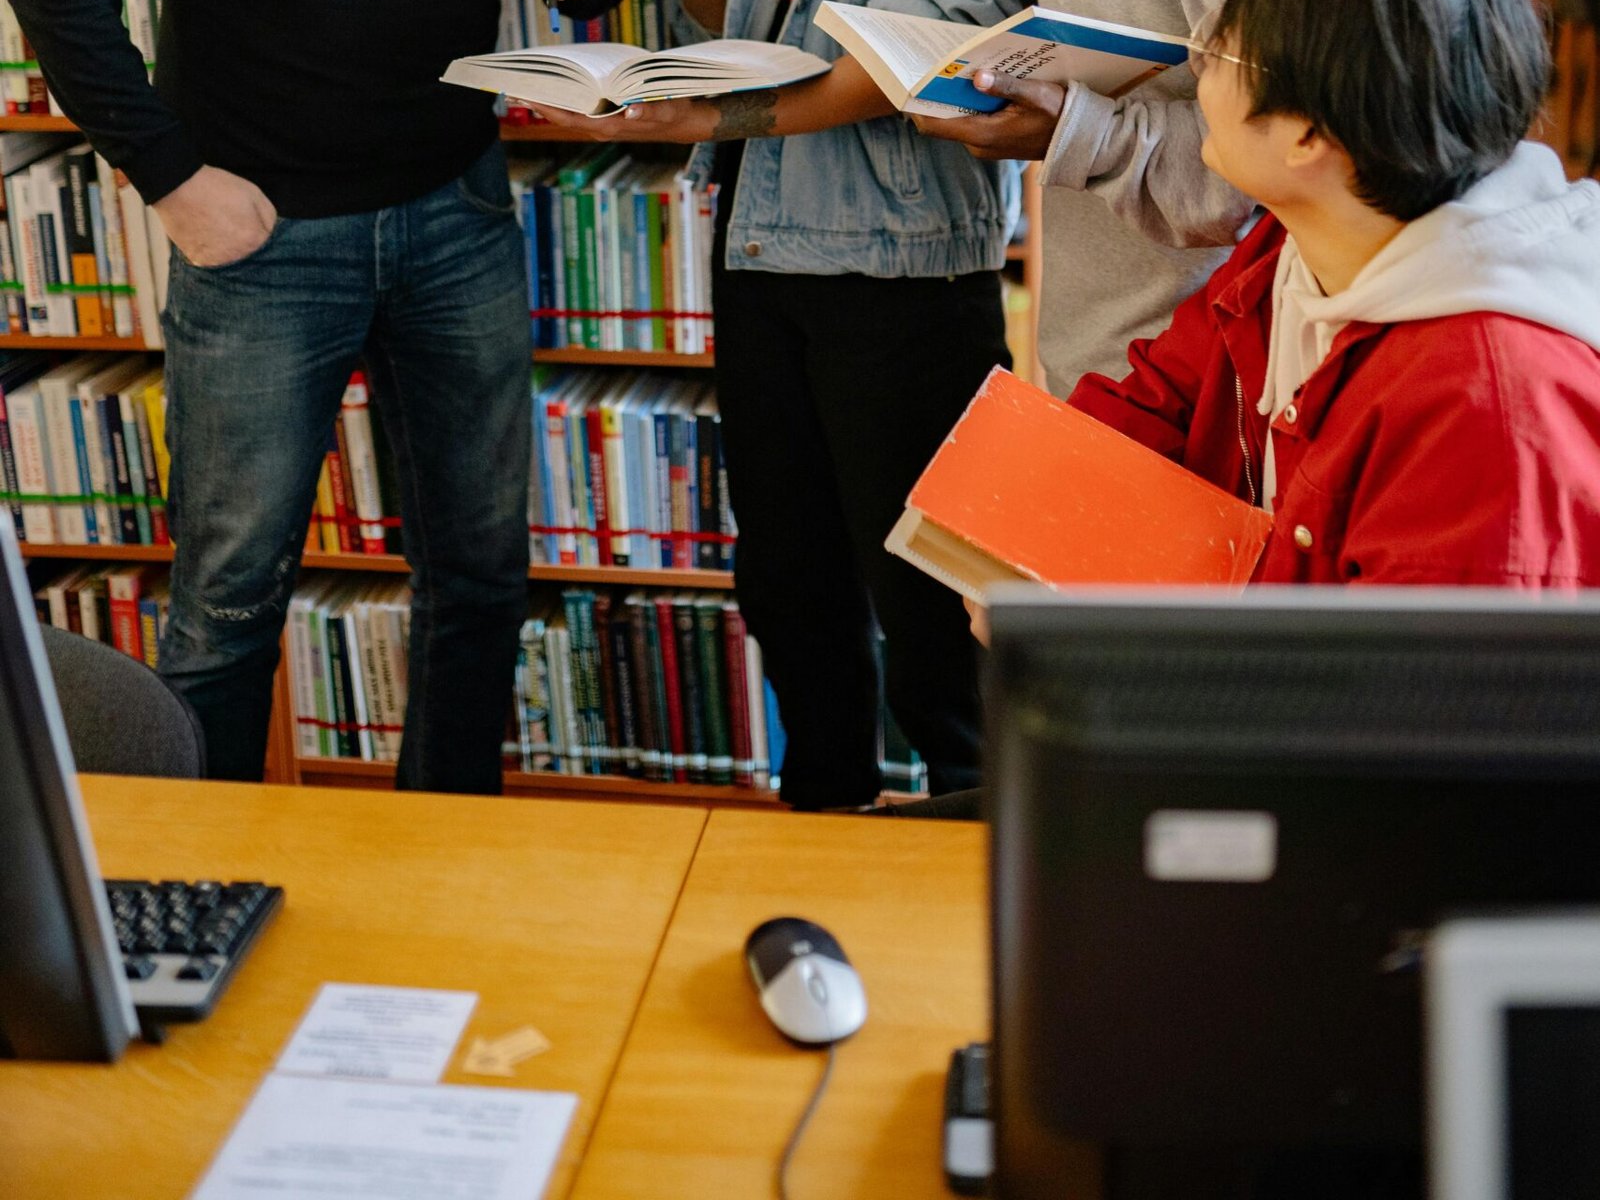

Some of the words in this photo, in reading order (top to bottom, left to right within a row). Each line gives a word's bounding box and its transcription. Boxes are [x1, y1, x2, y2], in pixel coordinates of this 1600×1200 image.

[991, 47, 1028, 72] ungs-
[1004, 42, 1059, 74] ammatik
[1016, 55, 1056, 80] eutsch
